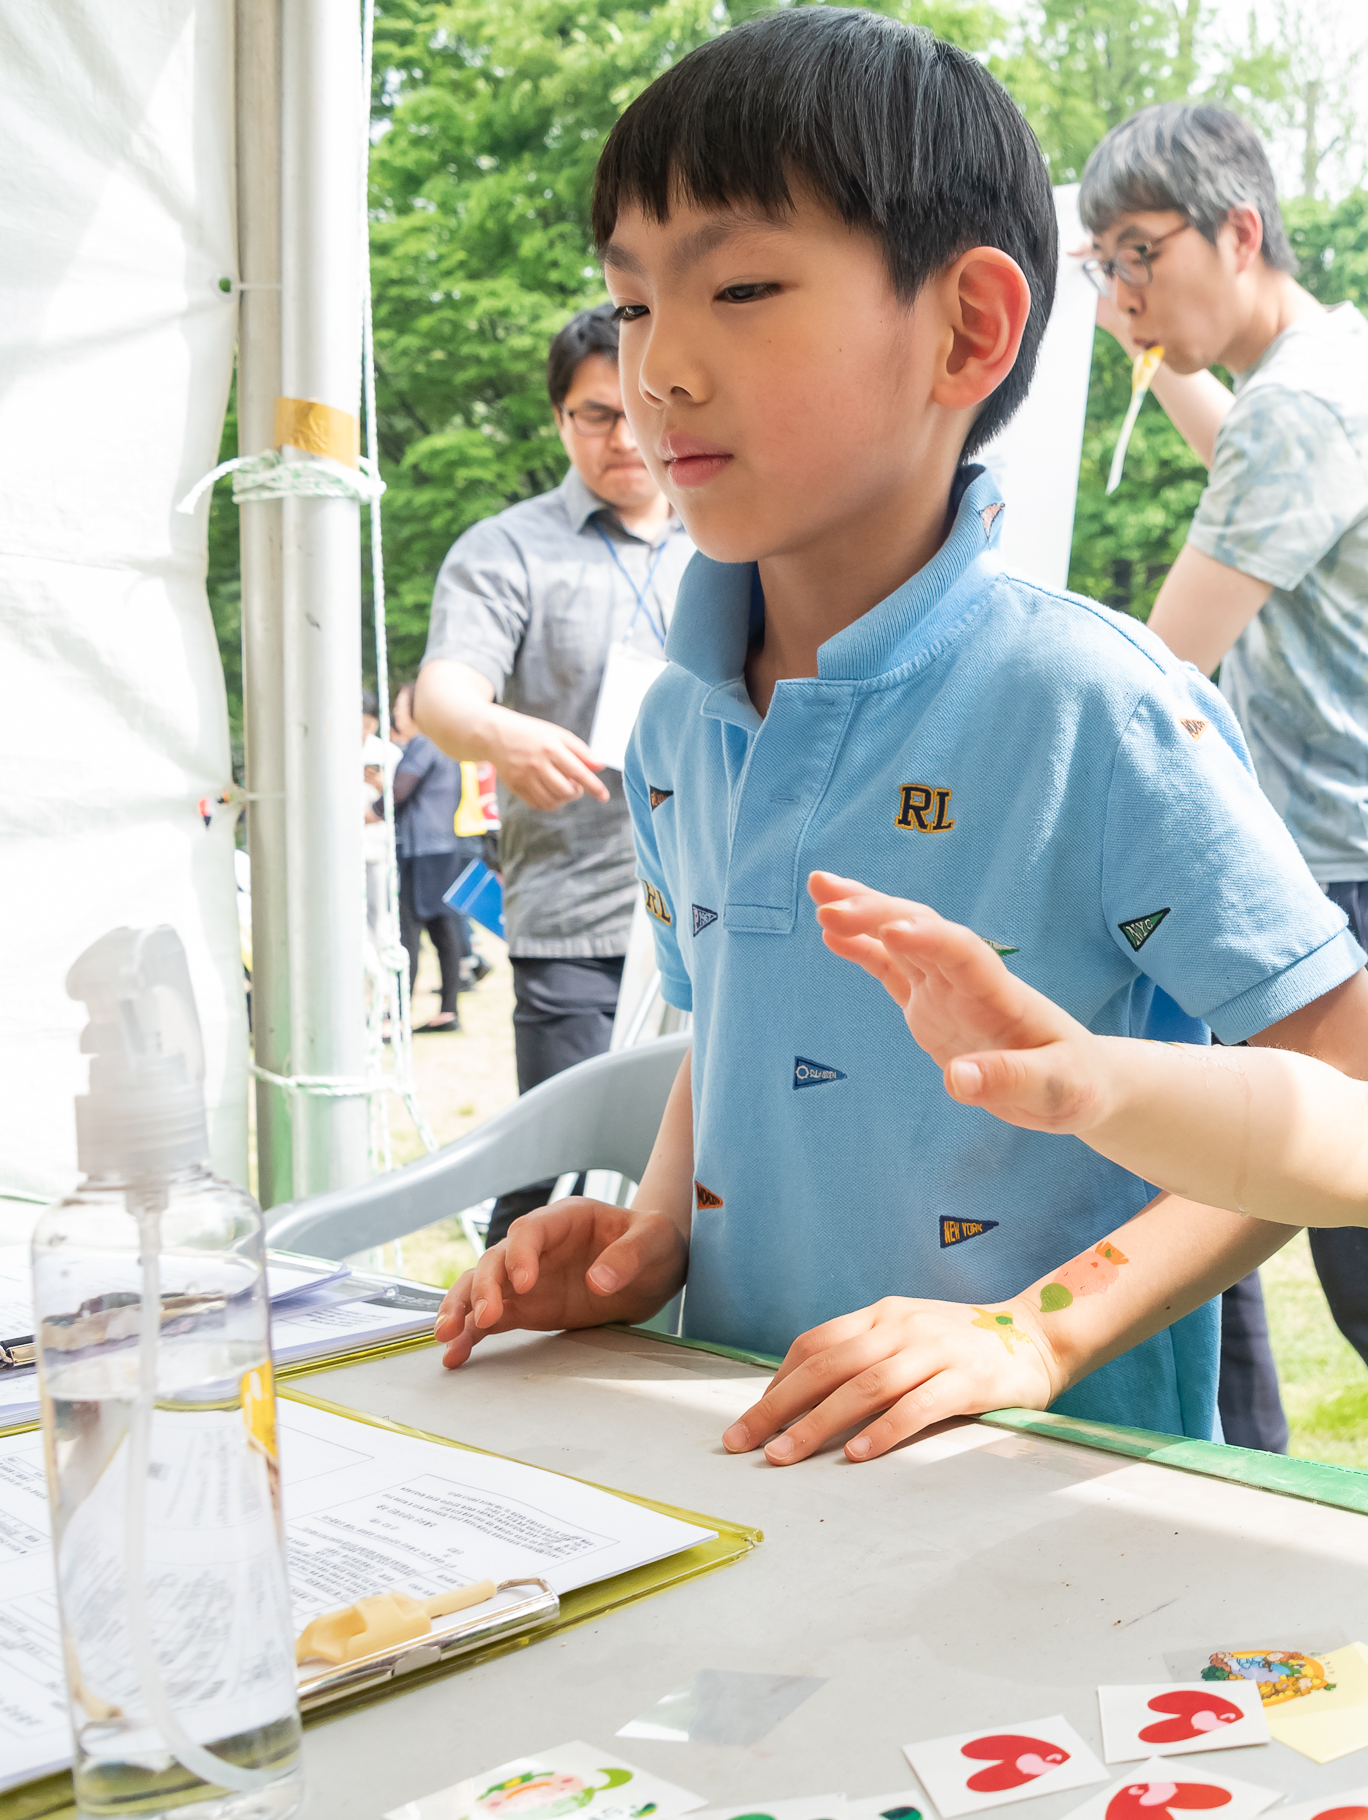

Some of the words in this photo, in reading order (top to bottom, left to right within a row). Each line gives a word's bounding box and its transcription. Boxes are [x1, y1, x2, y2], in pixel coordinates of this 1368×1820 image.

[894, 783, 956, 833] RL
[1125, 918, 1154, 946] NYC
[944, 1221, 960, 1243] NEW
[961, 1222, 983, 1237] YORK
